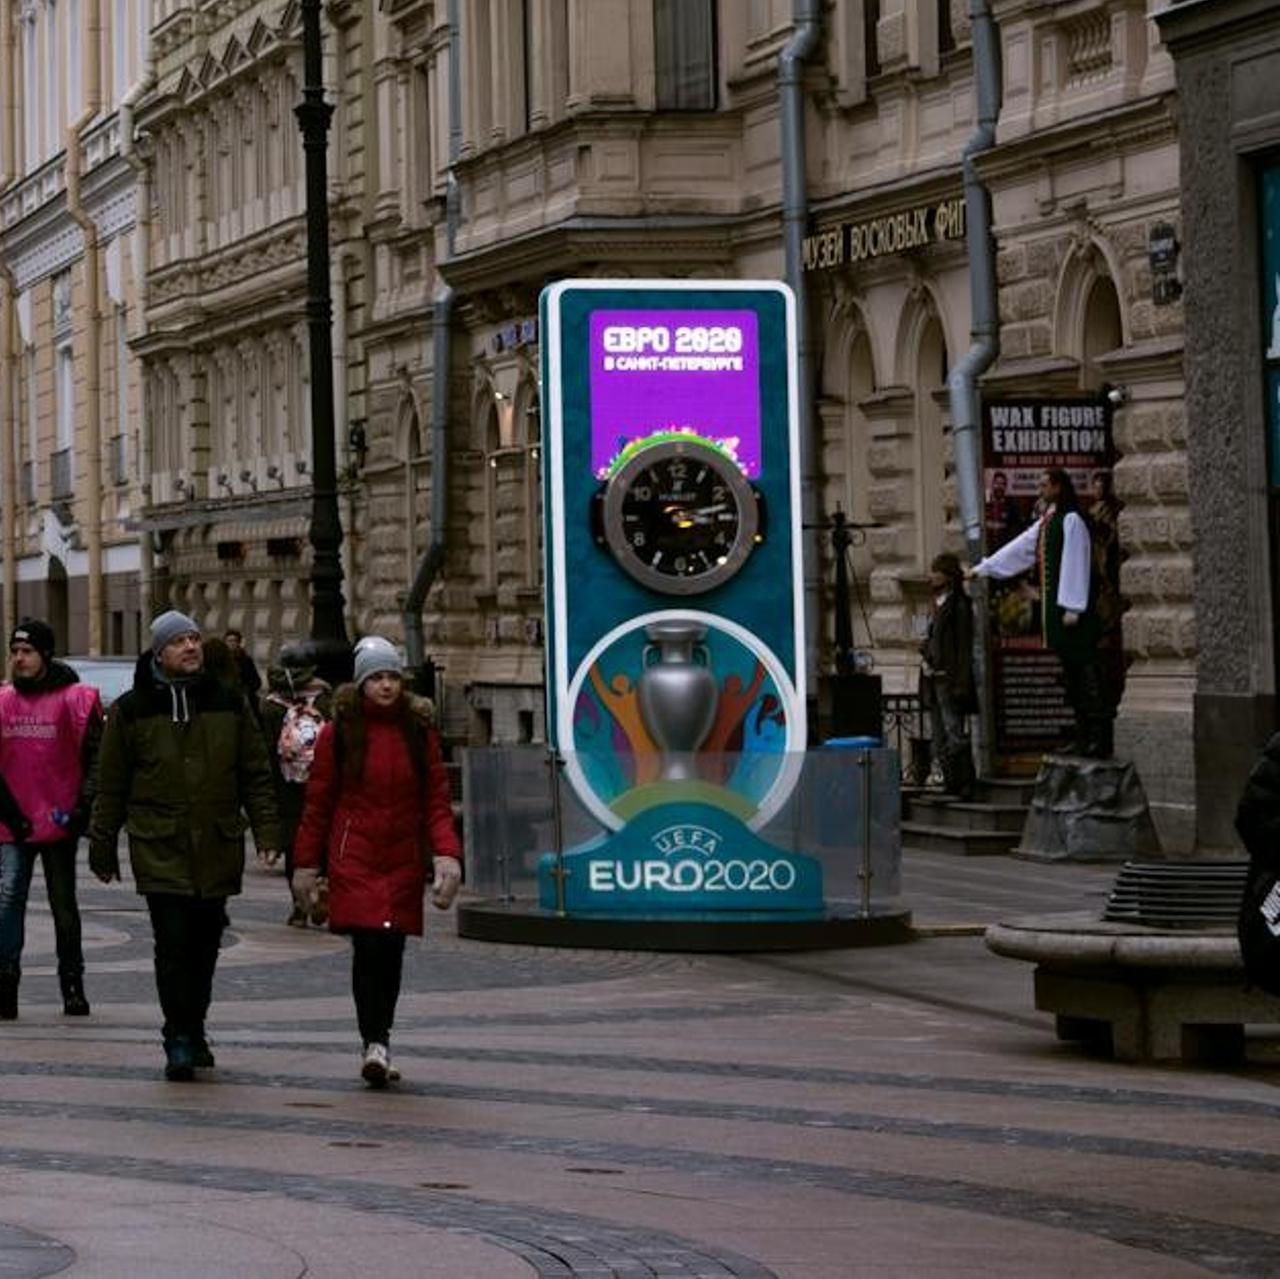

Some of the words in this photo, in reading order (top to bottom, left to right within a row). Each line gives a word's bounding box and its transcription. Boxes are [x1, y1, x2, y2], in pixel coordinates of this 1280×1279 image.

[851, 208, 929, 261] ВОСКОВЫХ
[604, 326, 670, 353] ЕВРО
[675, 326, 743, 354] 2020
[991, 406, 1035, 428] WAX
[1041, 406, 1105, 428] FIGURE
[993, 429, 1105, 453] EXHIBITION
[655, 829, 717, 854] UEFA
